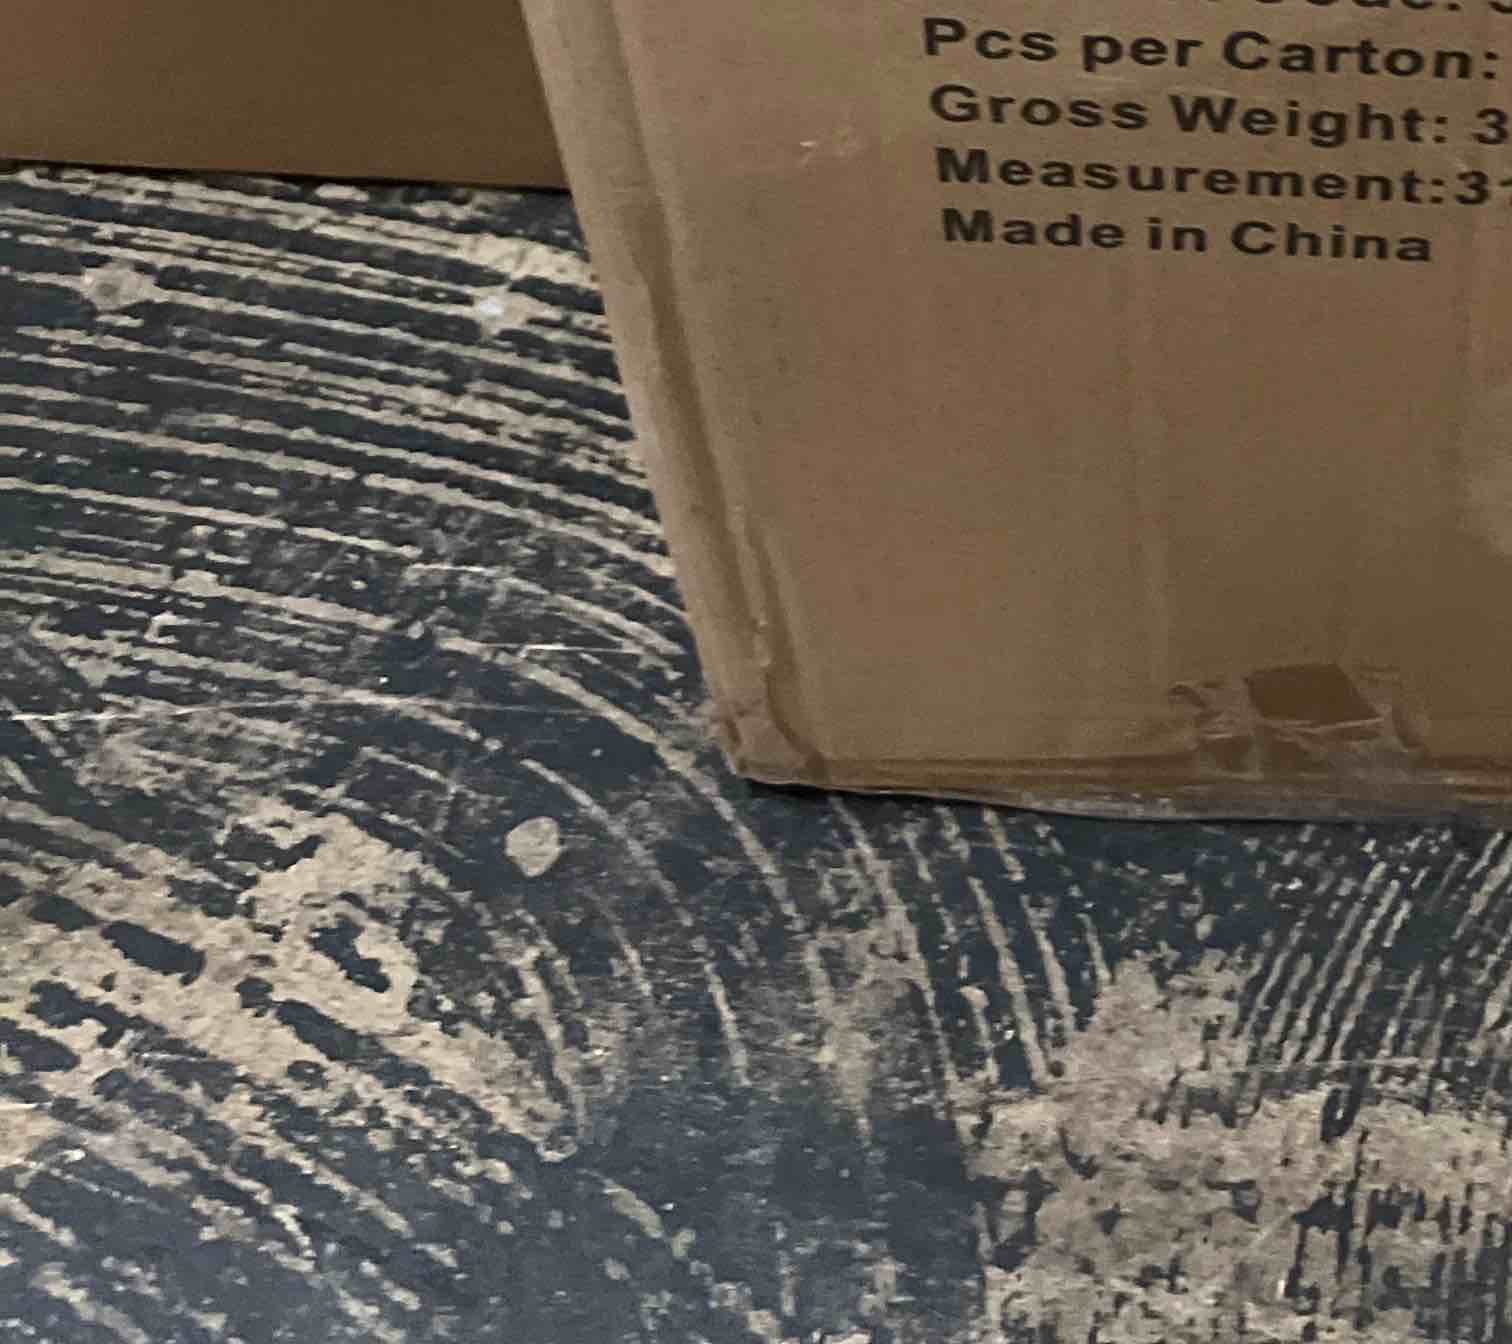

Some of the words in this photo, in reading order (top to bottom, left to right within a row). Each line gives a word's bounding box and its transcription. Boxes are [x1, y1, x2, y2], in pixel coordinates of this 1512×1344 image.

[922, 16, 1058, 62] Pcs
[1080, 32, 1204, 73] per
[1221, 30, 1499, 81] Carton:
[928, 83, 1150, 131] Gross
[1168, 92, 1449, 148] Weight:
[941, 207, 1127, 250] Made
[1146, 216, 1209, 254] in
[1230, 220, 1433, 263] China
